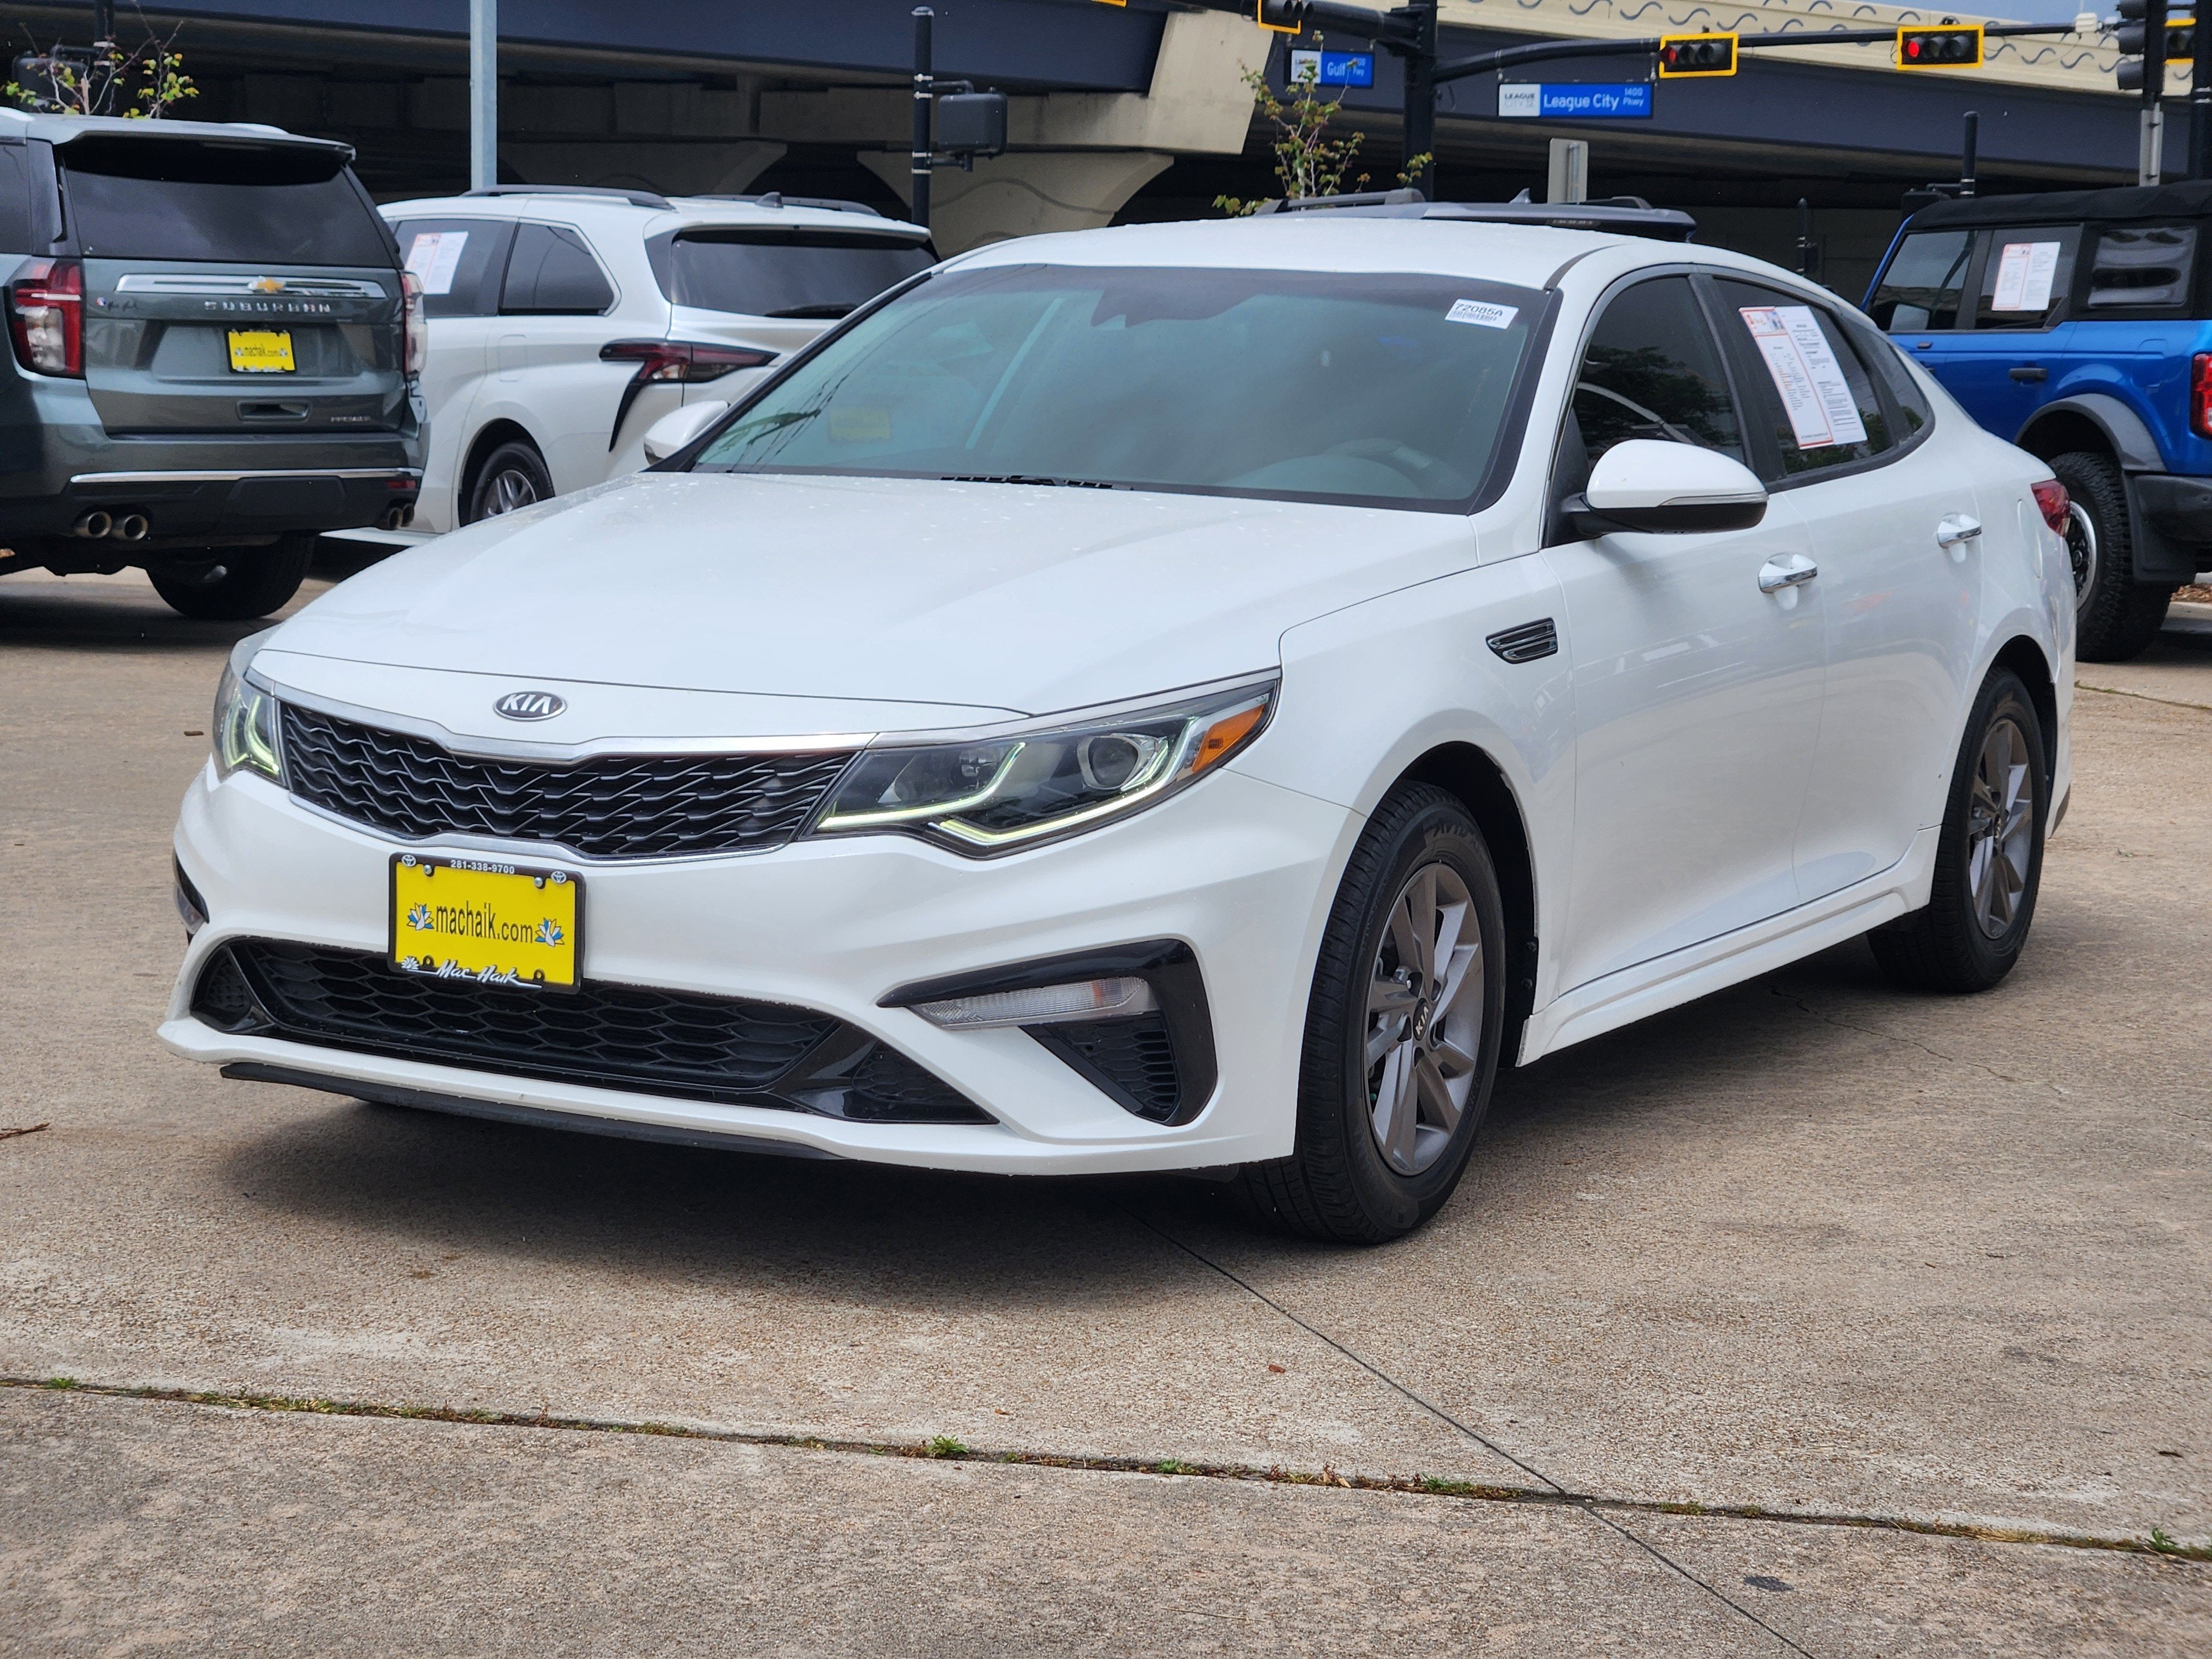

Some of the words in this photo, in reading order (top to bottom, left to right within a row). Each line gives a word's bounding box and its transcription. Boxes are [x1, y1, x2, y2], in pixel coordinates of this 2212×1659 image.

[1543, 93, 1590, 112] League
[1593, 93, 1620, 111] City
[204, 301, 331, 312] SUBURBAN
[1455, 303, 1503, 317] 72085A
[502, 693, 552, 714] KIA
[450, 859, 515, 874] 281-338-9700
[436, 900, 533, 943] machaik.com
[437, 959, 476, 979] Mac
[476, 964, 520, 985] Haik
[1415, 1005, 1429, 1036] KIA
